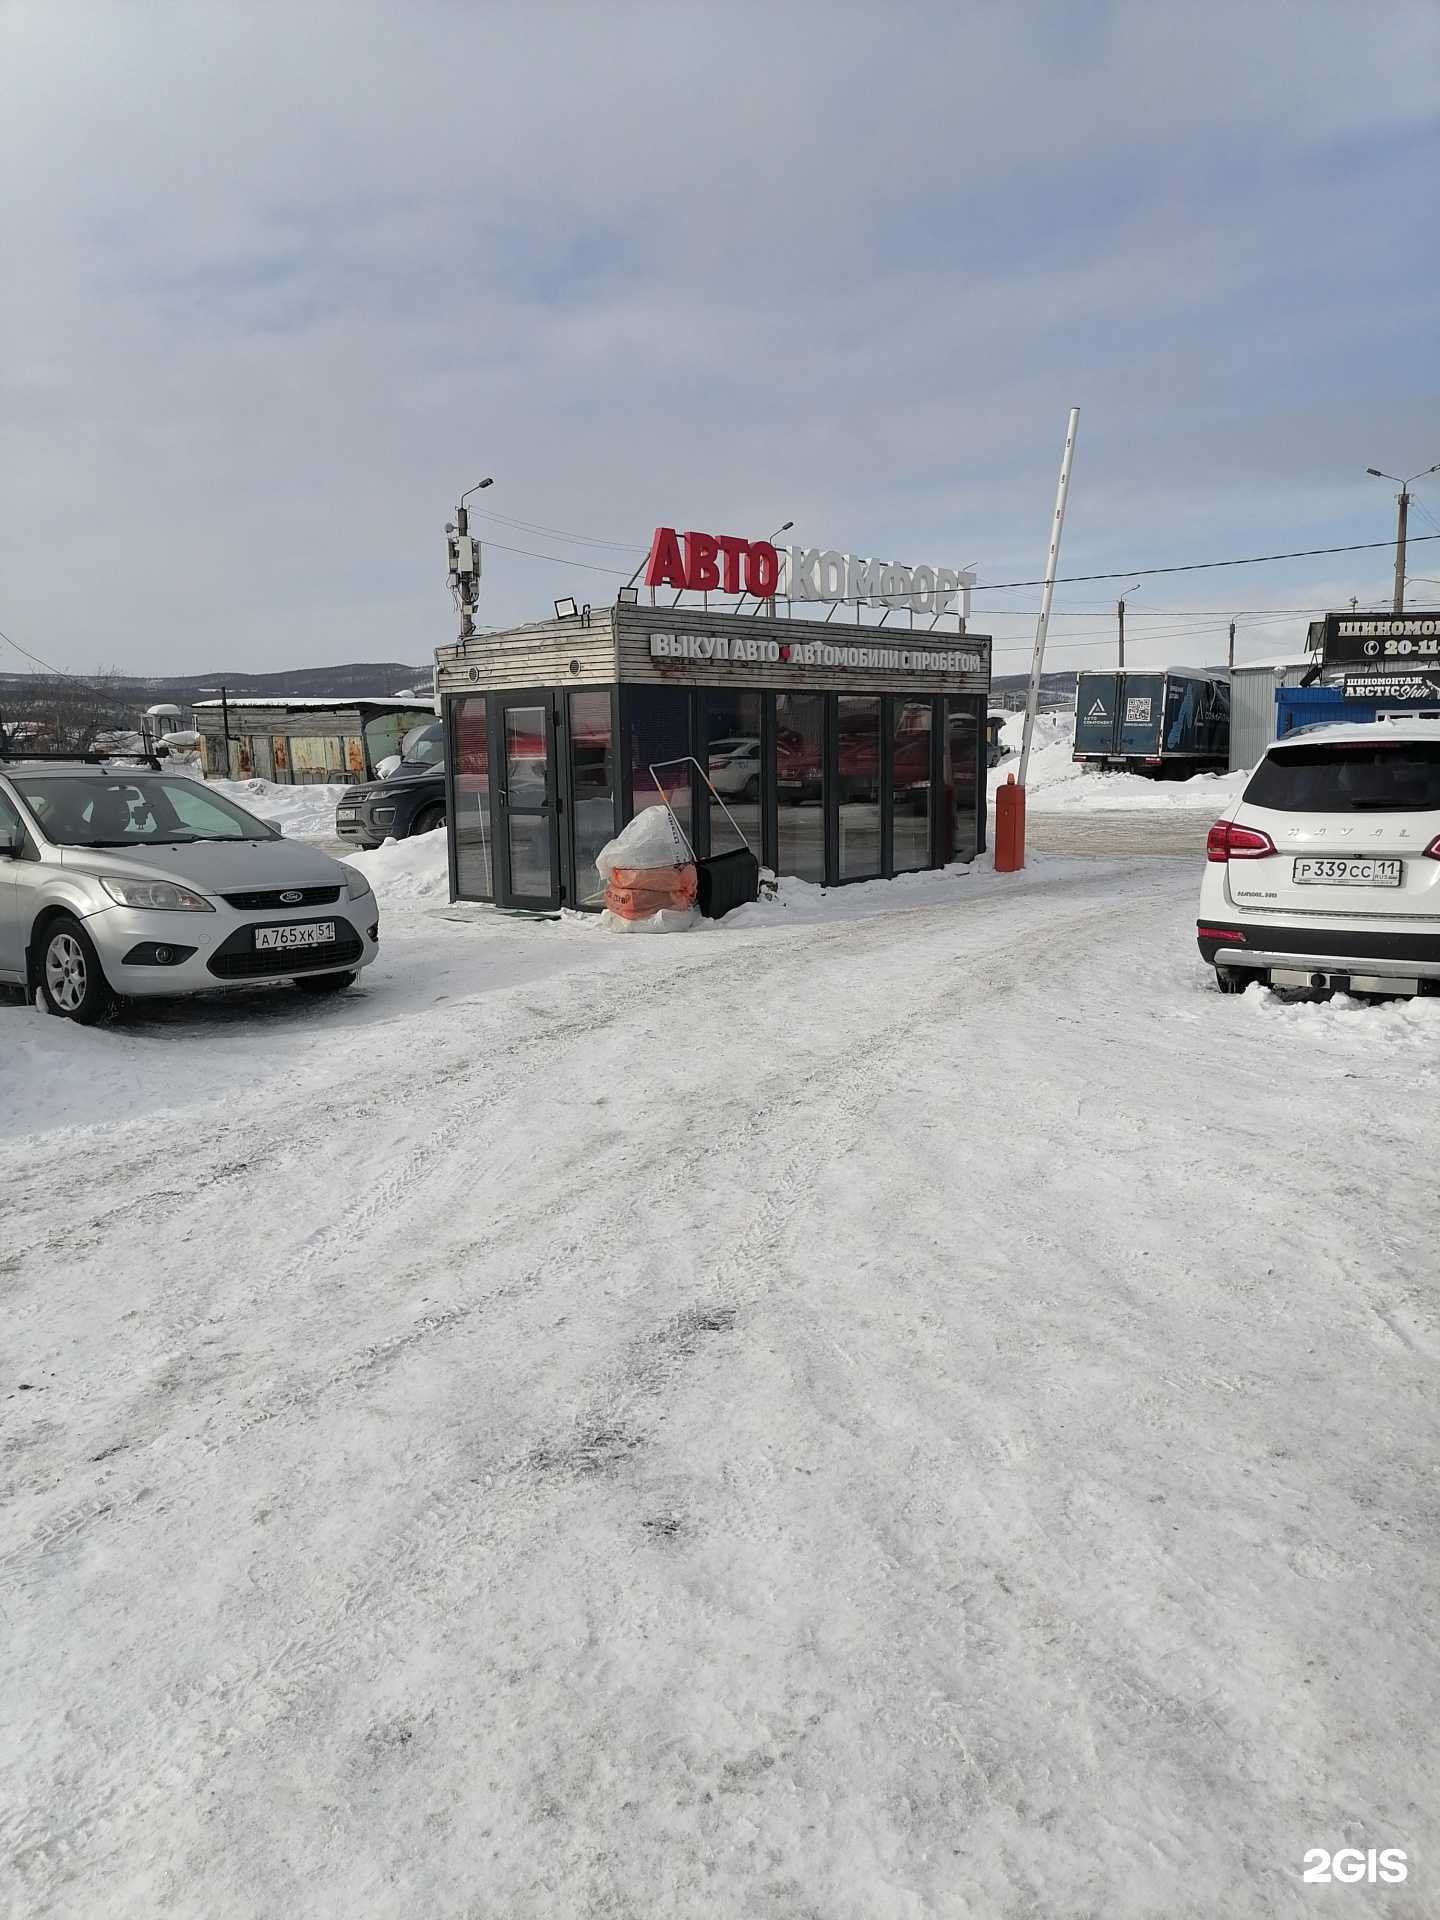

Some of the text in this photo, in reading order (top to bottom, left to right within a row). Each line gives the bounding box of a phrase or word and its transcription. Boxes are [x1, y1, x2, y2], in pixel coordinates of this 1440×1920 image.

[645, 527, 977, 619] АВТО КОМФОРТ
[650, 633, 729, 660] ВЫКУП
[728, 639, 780, 662] АВТО
[789, 641, 899, 669] АВТОМОБИЛИ
[912, 651, 981, 673] ПРОБЕГОМ
[1346, 676, 1423, 686] ШИНОМОНТАЖ
